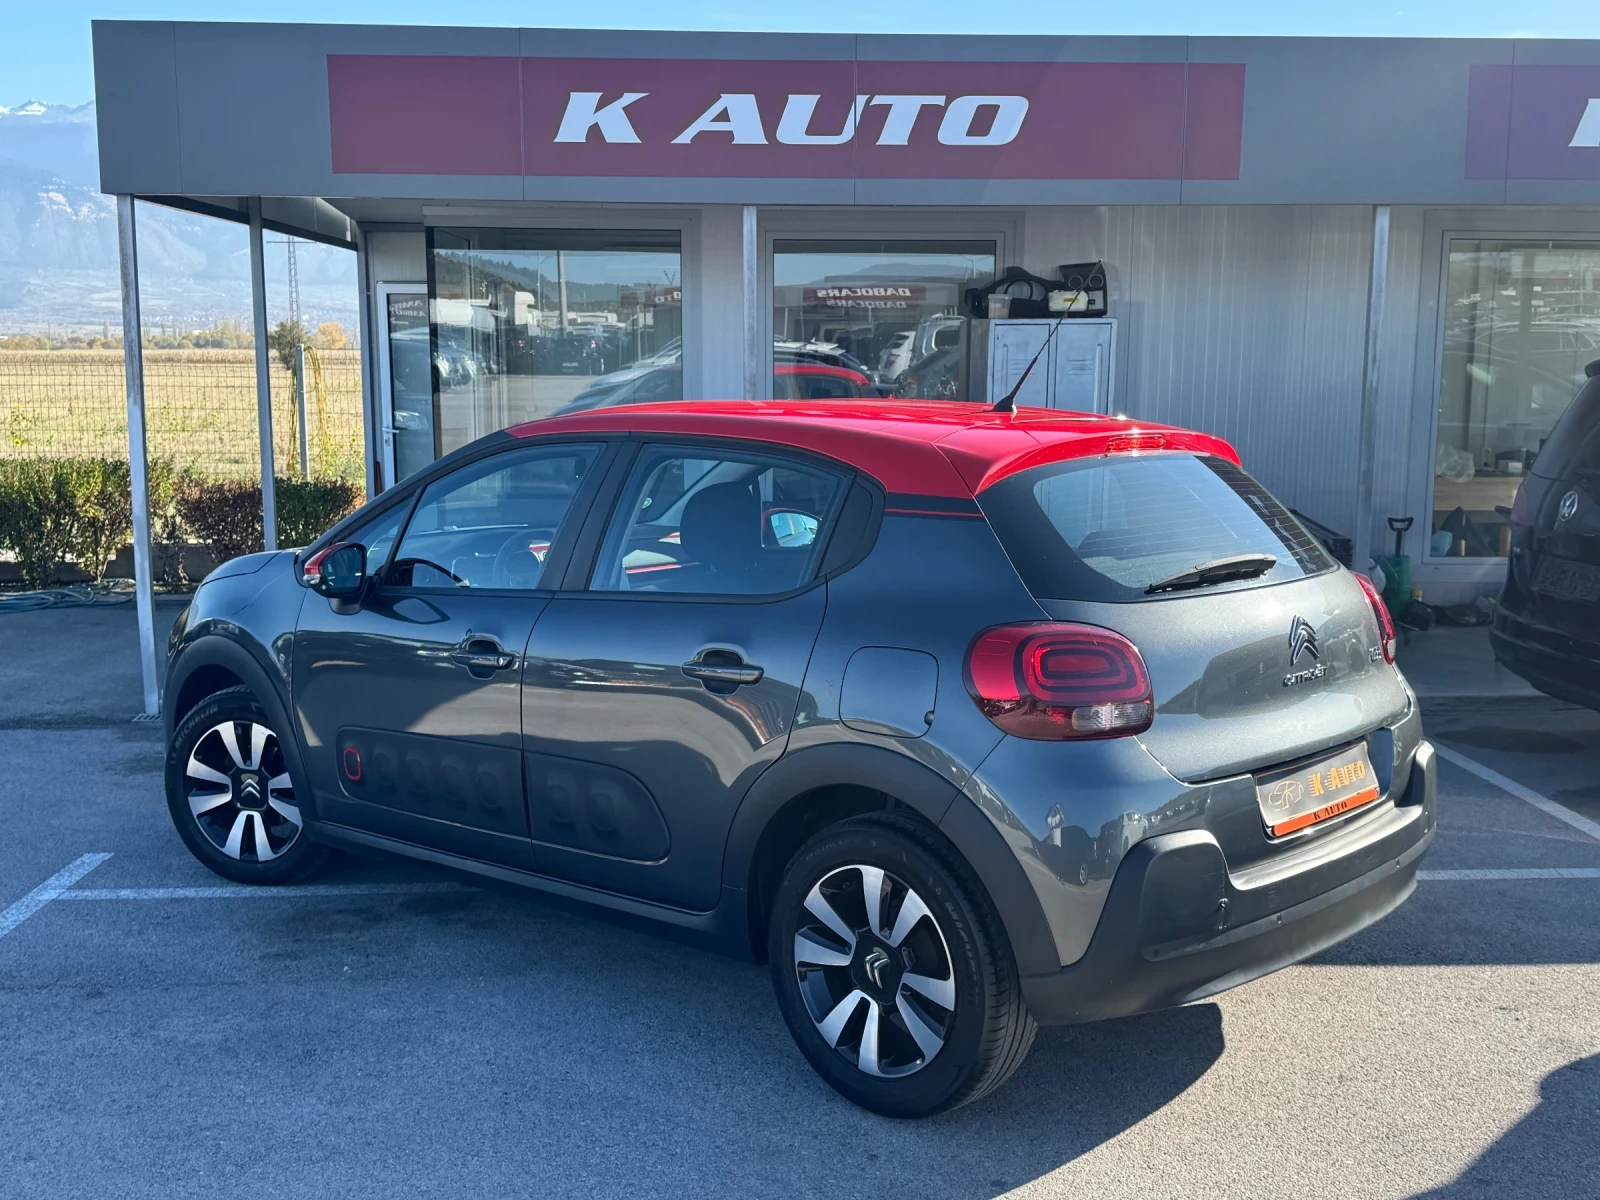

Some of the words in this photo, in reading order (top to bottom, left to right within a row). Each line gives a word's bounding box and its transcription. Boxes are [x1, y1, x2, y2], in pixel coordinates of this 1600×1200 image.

[552, 91, 651, 145] K
[670, 93, 1030, 147] AUTO
[1307, 772, 1324, 797] K
[1312, 811, 1321, 820] K
[1324, 801, 1348, 816] AUTO
